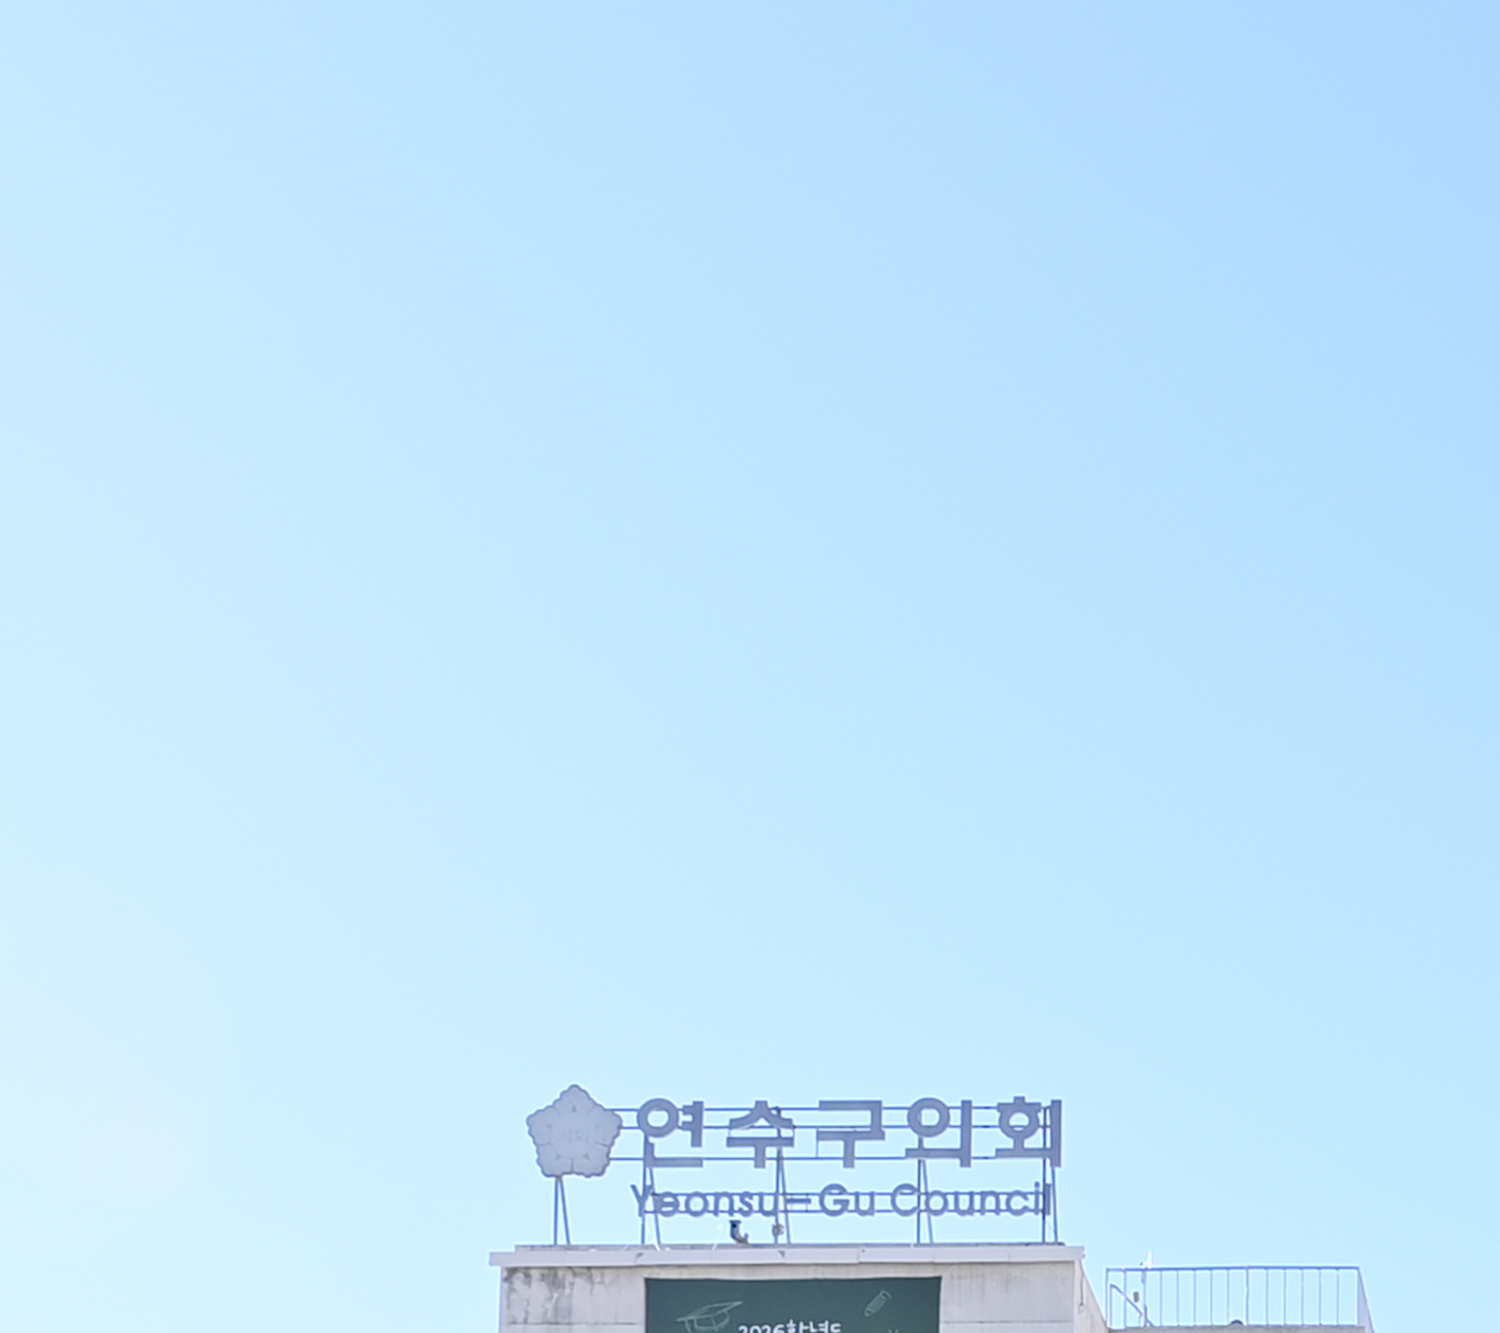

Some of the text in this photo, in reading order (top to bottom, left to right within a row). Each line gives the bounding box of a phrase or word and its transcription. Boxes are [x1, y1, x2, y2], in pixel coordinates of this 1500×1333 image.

[636, 1096, 1062, 1169] 연수구의회
[630, 1182, 1052, 1218] Yeonsu-Gu Council
